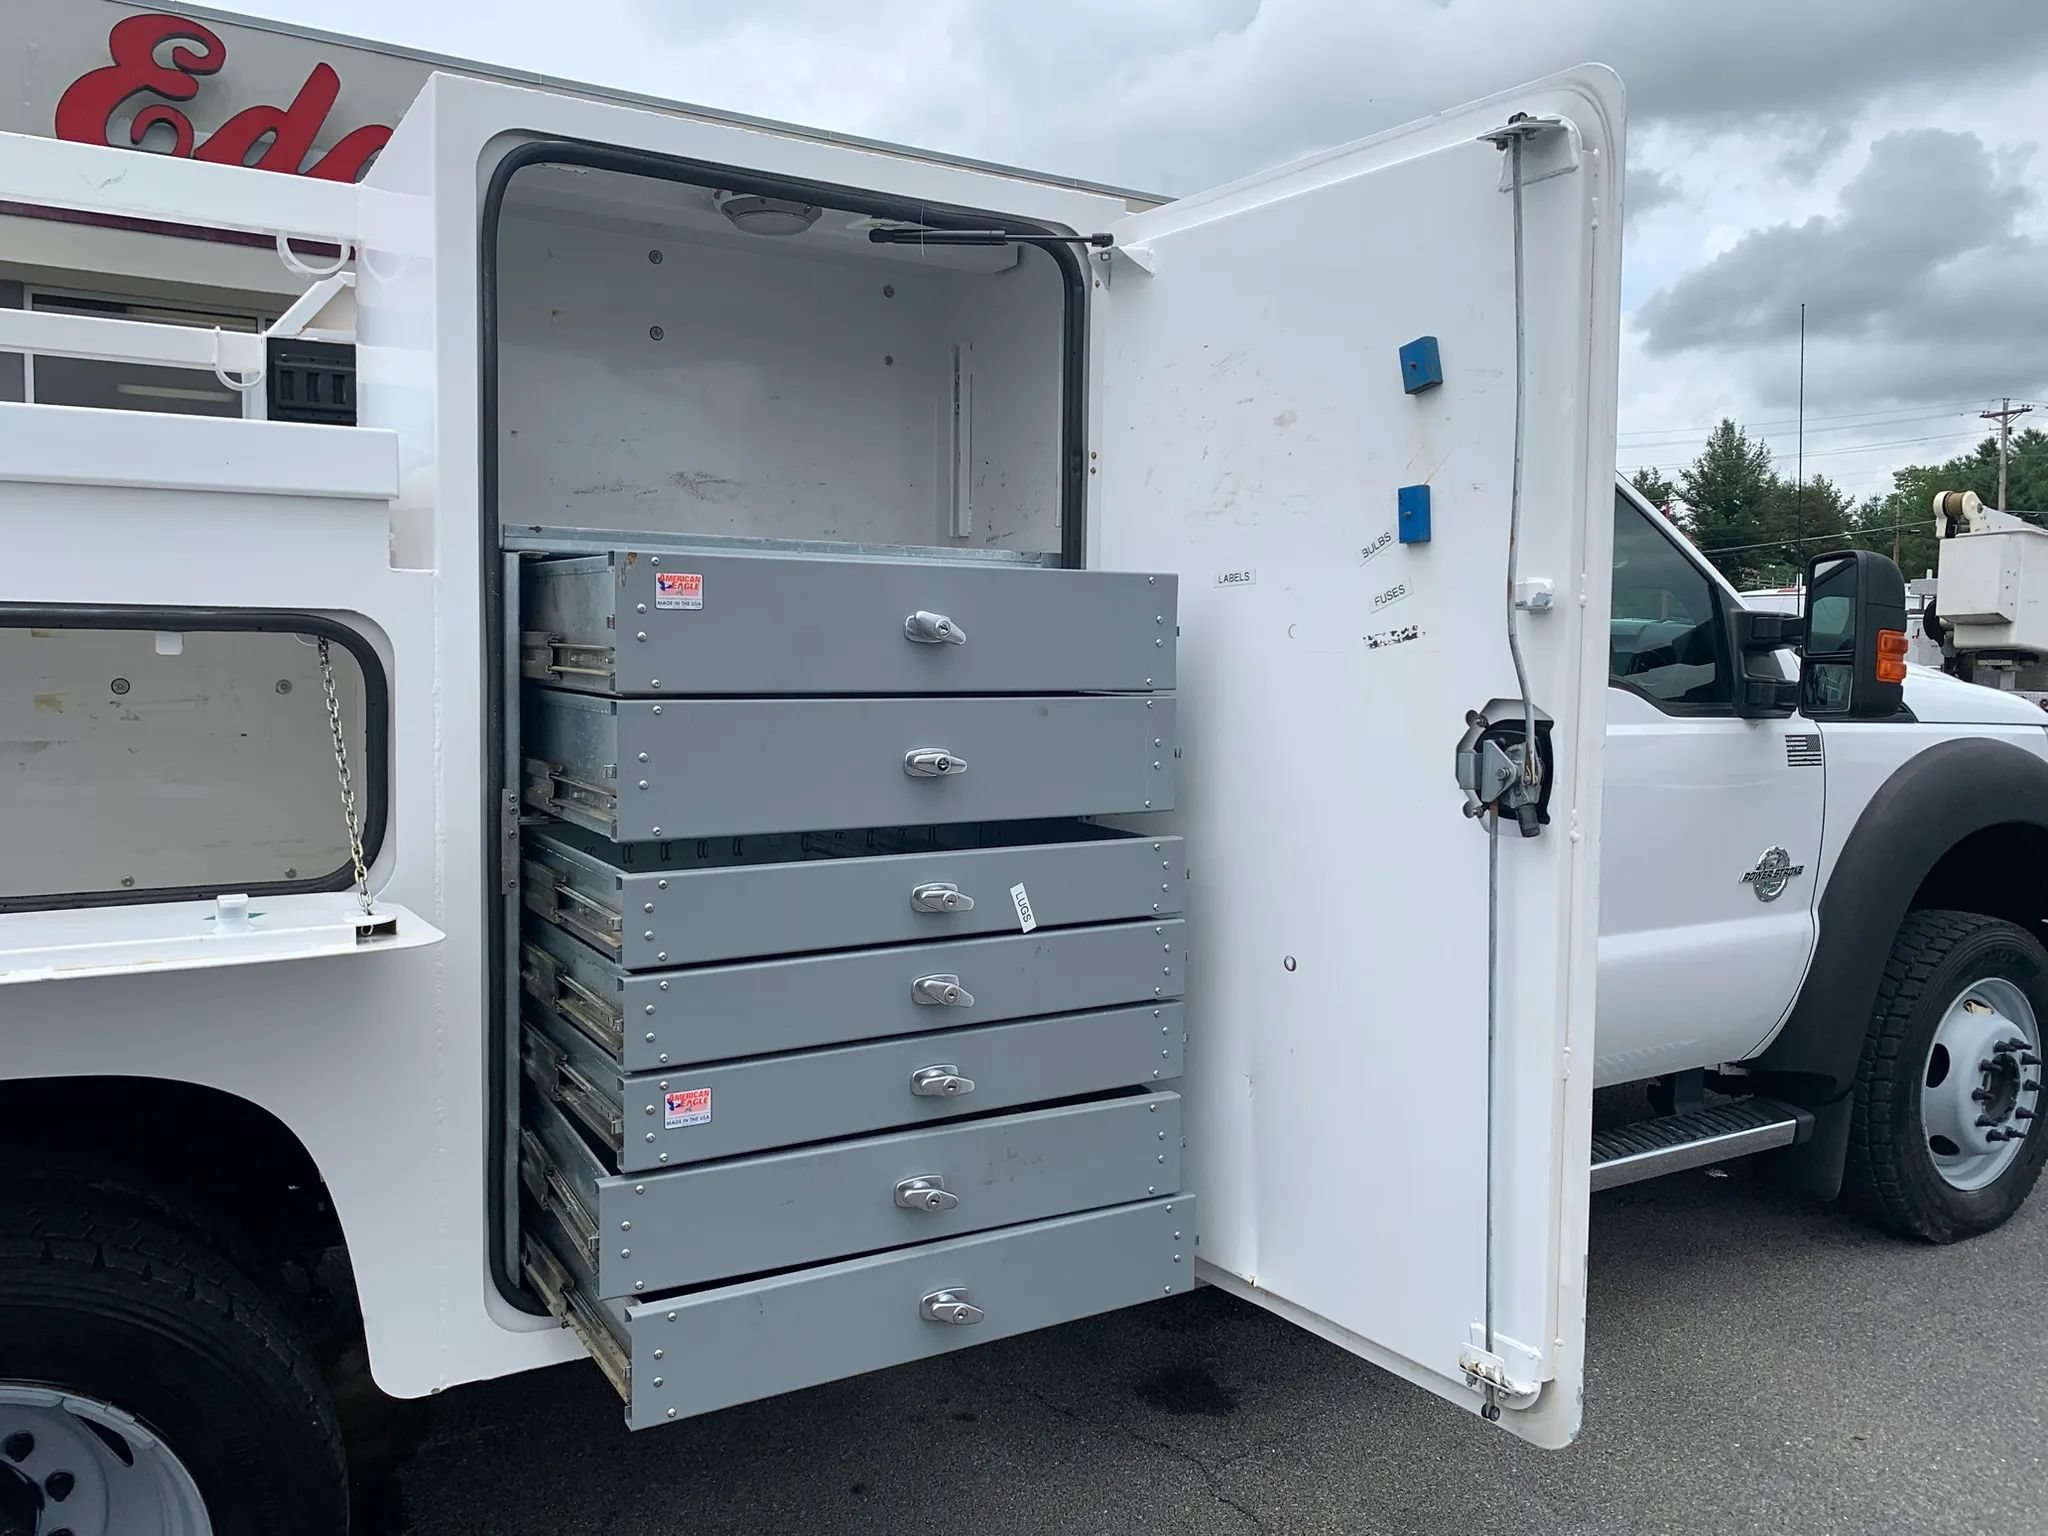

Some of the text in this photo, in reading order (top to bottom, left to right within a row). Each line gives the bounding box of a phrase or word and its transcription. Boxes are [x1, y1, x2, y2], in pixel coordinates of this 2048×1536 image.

[1361, 532, 1392, 559] BULBS
[659, 574, 701, 583] AMERICAN
[1217, 572, 1250, 584] LABELS
[671, 582, 700, 592] EAGLE
[1374, 584, 1406, 607] FUSES
[1015, 891, 1032, 923] LUGS
[669, 1090, 709, 1101] AMERICAN
[680, 1097, 709, 1107] EAGLE
